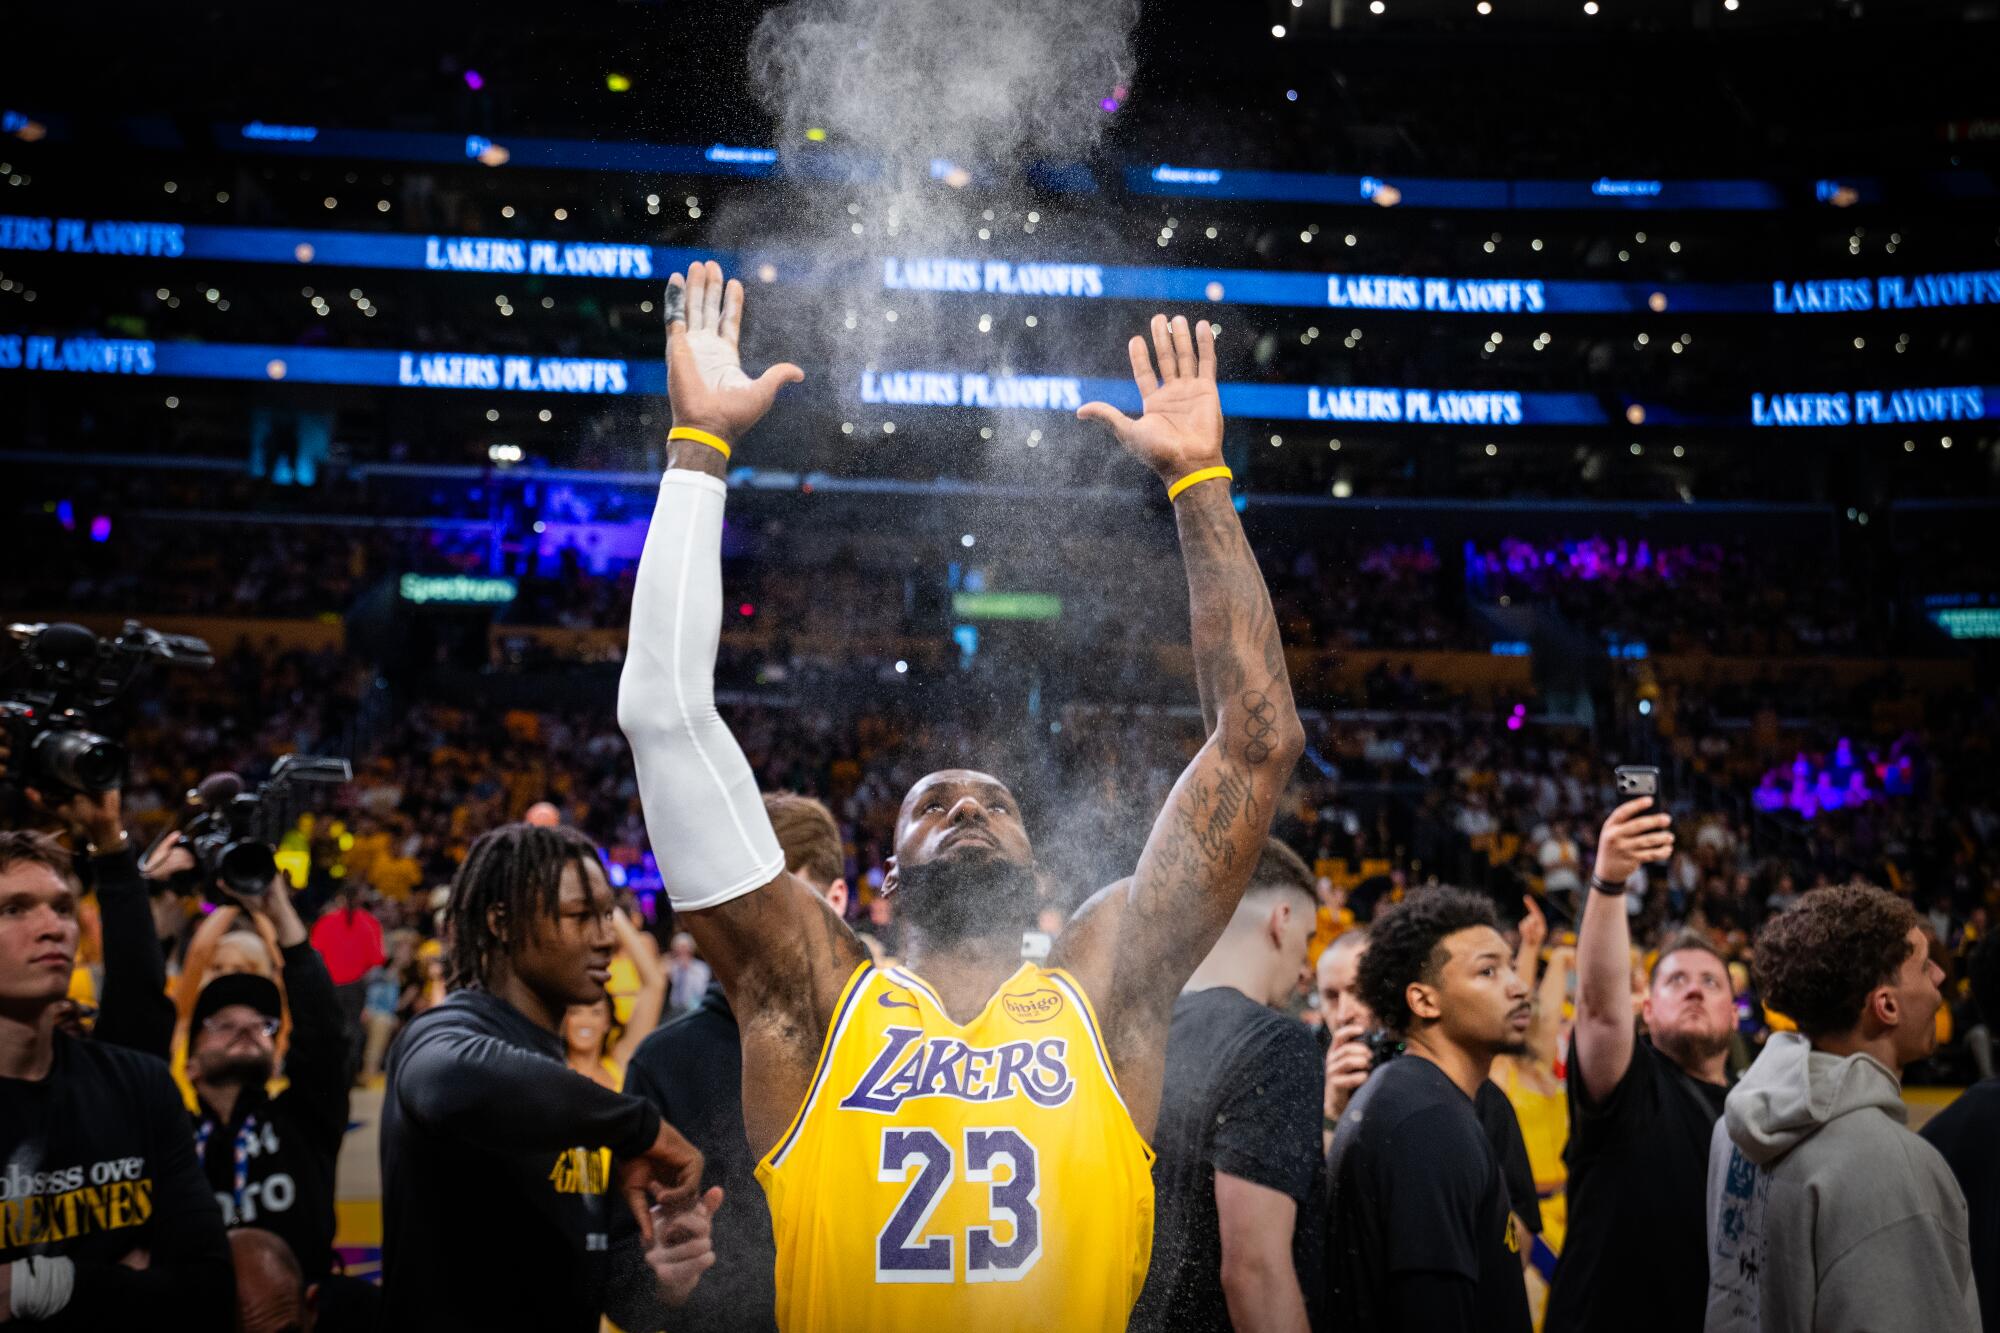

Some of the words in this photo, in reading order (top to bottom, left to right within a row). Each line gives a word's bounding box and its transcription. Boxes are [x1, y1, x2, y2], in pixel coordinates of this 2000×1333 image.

[55, 218, 184, 257] PLAYOFFS
[426, 235, 526, 273] LAKERS
[528, 240, 652, 278] PLAYOFFS
[885, 257, 981, 292] LAKERS
[984, 260, 1103, 297] PLAYOFFS
[1327, 274, 1421, 310] LAKERS
[1423, 278, 1545, 312] PLAYOFFS
[1773, 277, 1873, 313] LAKERS
[25, 335, 156, 375] PLAYOFFS
[399, 351, 499, 389] LAKERS
[501, 355, 627, 394] PLAYOFFS
[861, 371, 958, 404] LAKERS
[960, 373, 1083, 411] PLAYOFFS
[1307, 387, 1401, 422] LAKERS
[1404, 388, 1522, 425] PLAYOFFS
[1751, 392, 1851, 426] LAKERS
[1854, 386, 1984, 424] PLAYOFFS
[1006, 996, 1058, 1012] bibigo
[838, 1025, 1076, 1115] LAKERS
[875, 1126, 1043, 1284] 23
